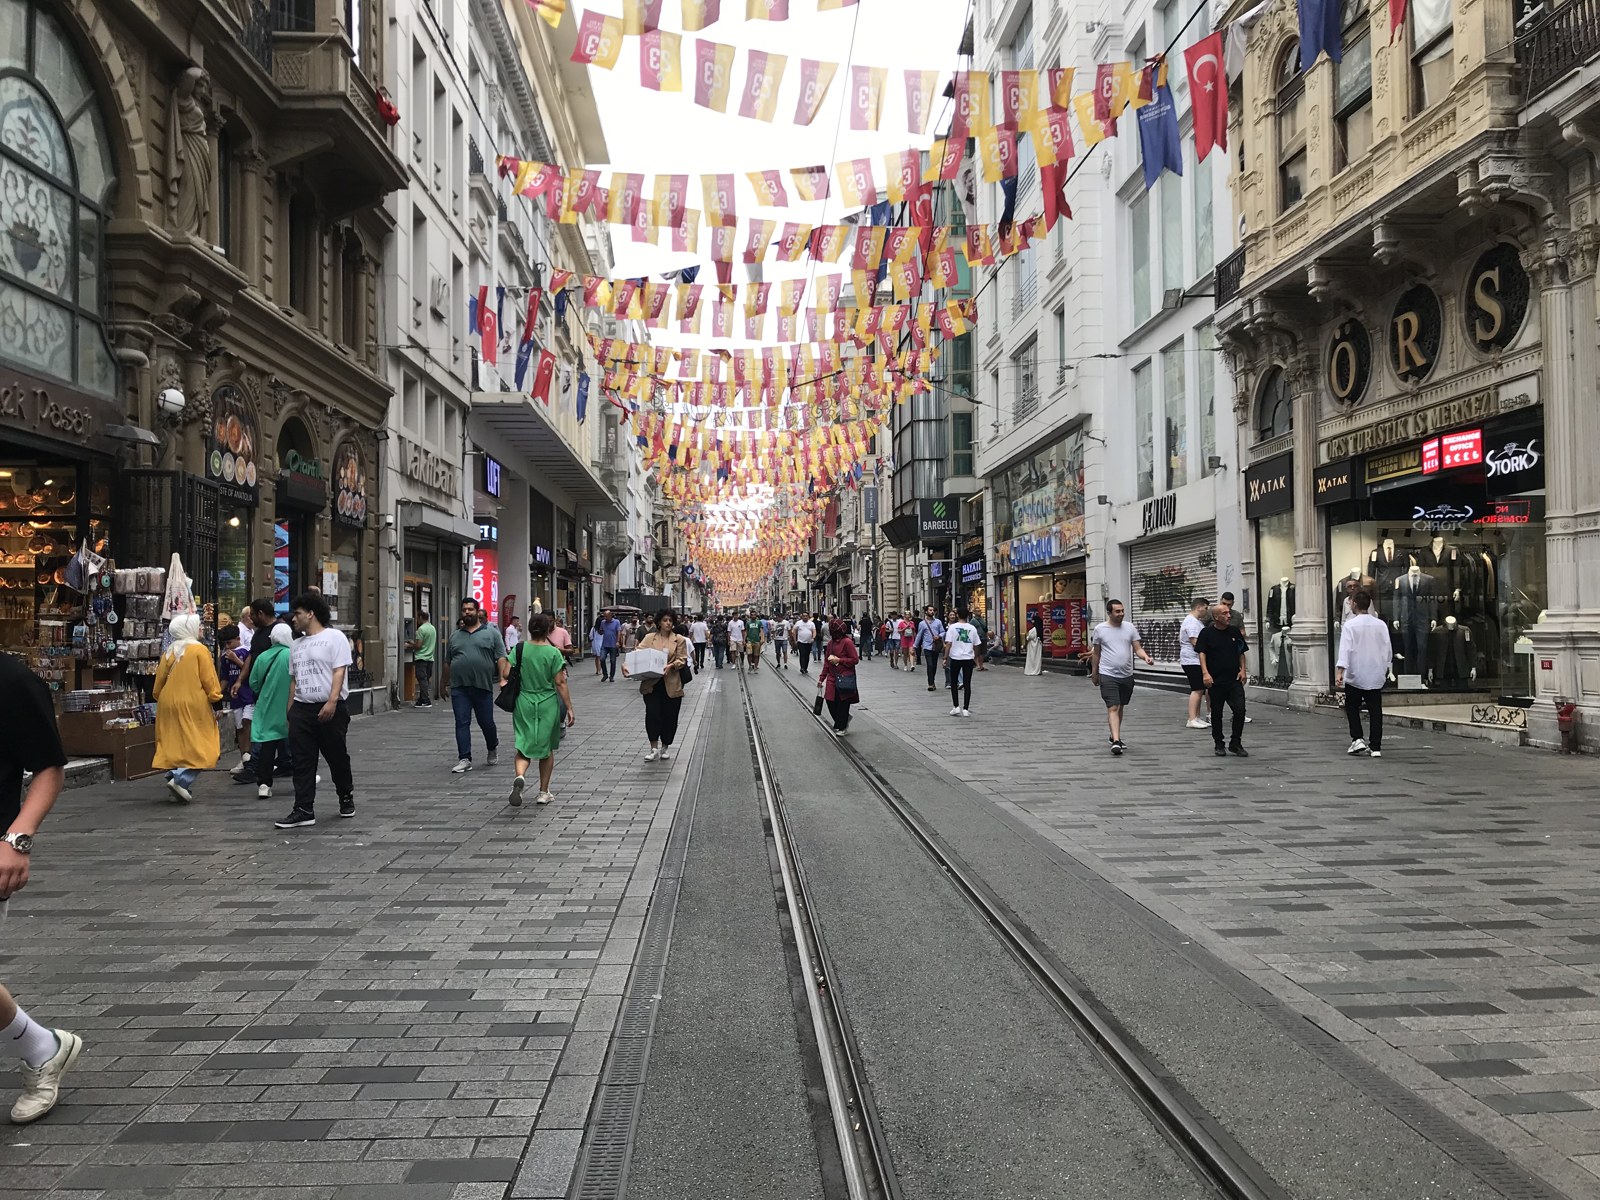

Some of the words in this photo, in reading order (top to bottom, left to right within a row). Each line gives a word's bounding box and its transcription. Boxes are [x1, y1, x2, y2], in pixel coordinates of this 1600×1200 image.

[1042, 124, 1061, 147] 23
[990, 141, 1008, 162] 23
[846, 172, 866, 193] 23
[660, 191, 677, 210] 23
[711, 191, 727, 209] 23
[1330, 266, 1501, 399] ÖRS
[1350, 418, 1409, 454] TURİSTİK
[1428, 384, 1500, 431] MERKEZİ
[1443, 431, 1481, 445] EXCHANGE
[1450, 442, 1474, 452] OFFICE
[1369, 456, 1398, 470] WESTERN
[1486, 439, 1538, 478] STORKS
[1378, 463, 1398, 475] UNION
[480, 526, 489, 538] FT
[922, 520, 958, 531] BARGELLO
[473, 555, 484, 610] OUNT
[301, 667, 323, 677] LONELY
[305, 686, 322, 694] TIME
